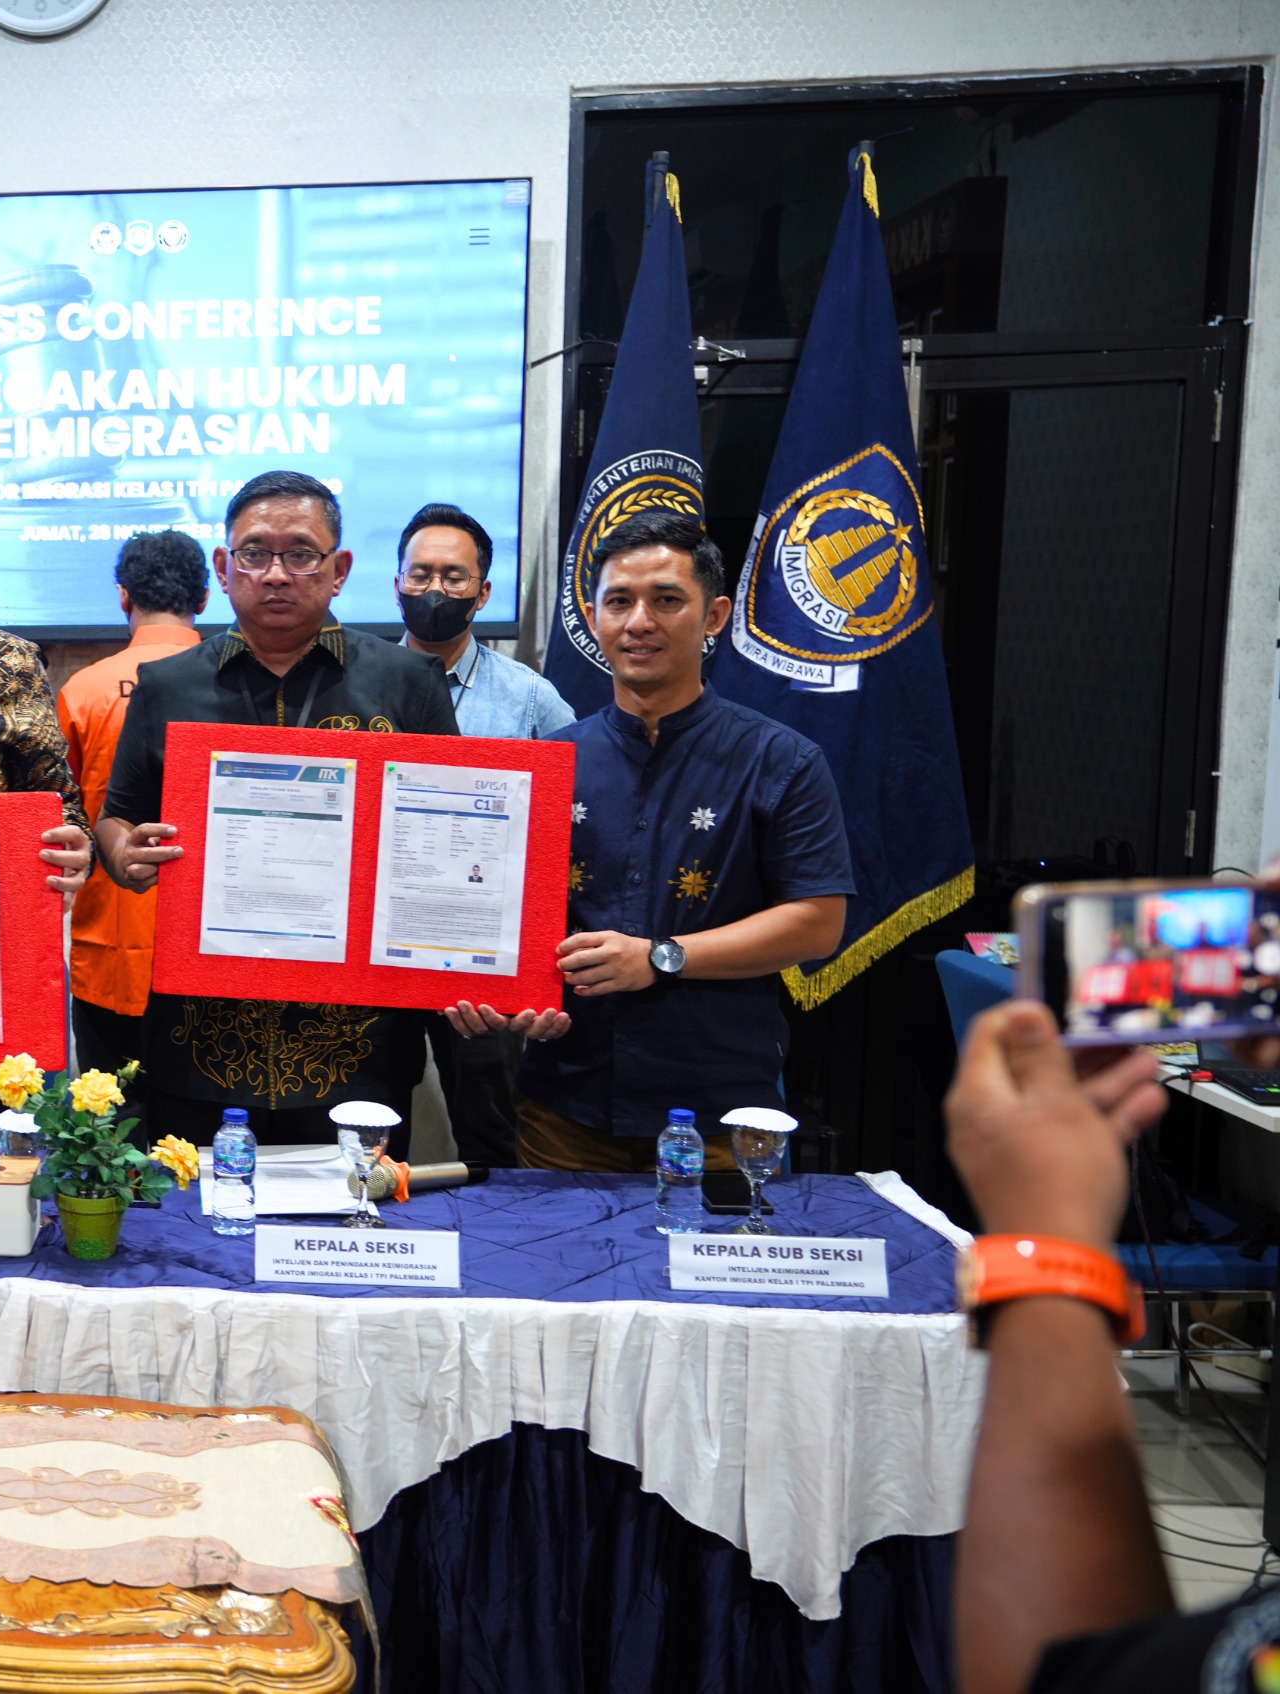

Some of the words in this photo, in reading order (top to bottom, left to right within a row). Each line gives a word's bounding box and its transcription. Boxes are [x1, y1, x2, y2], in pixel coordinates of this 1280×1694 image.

[56, 296, 382, 341] CONFERENCE
[208, 363, 406, 409] HUKUM
[114, 481, 175, 498] KELAS
[177, 481, 184, 497] I
[186, 480, 218, 497] TPI
[19, 524, 87, 542] JUMAT,
[785, 551, 843, 628] IMIGRASI
[741, 639, 768, 662] WIRA
[771, 657, 825, 680] WIBAWA
[474, 799, 491, 811] C1
[294, 1239, 359, 1252] KEPALA
[365, 1241, 415, 1254] SEKSI
[693, 1244, 762, 1258] KEPALA
[767, 1246, 804, 1259] SUB
[810, 1248, 863, 1261] SEKSI
[273, 1258, 312, 1266] INTELIJEN
[331, 1260, 380, 1268] PENINDAKAN
[382, 1262, 437, 1270] KEIMIGRASIAN
[772, 1267, 830, 1276] KEIMIGRASIAN
[308, 1270, 342, 1278] IMIGRASI
[694, 1275, 727, 1283] KANTOR
[816, 1280, 865, 1288] PALEMBANG
